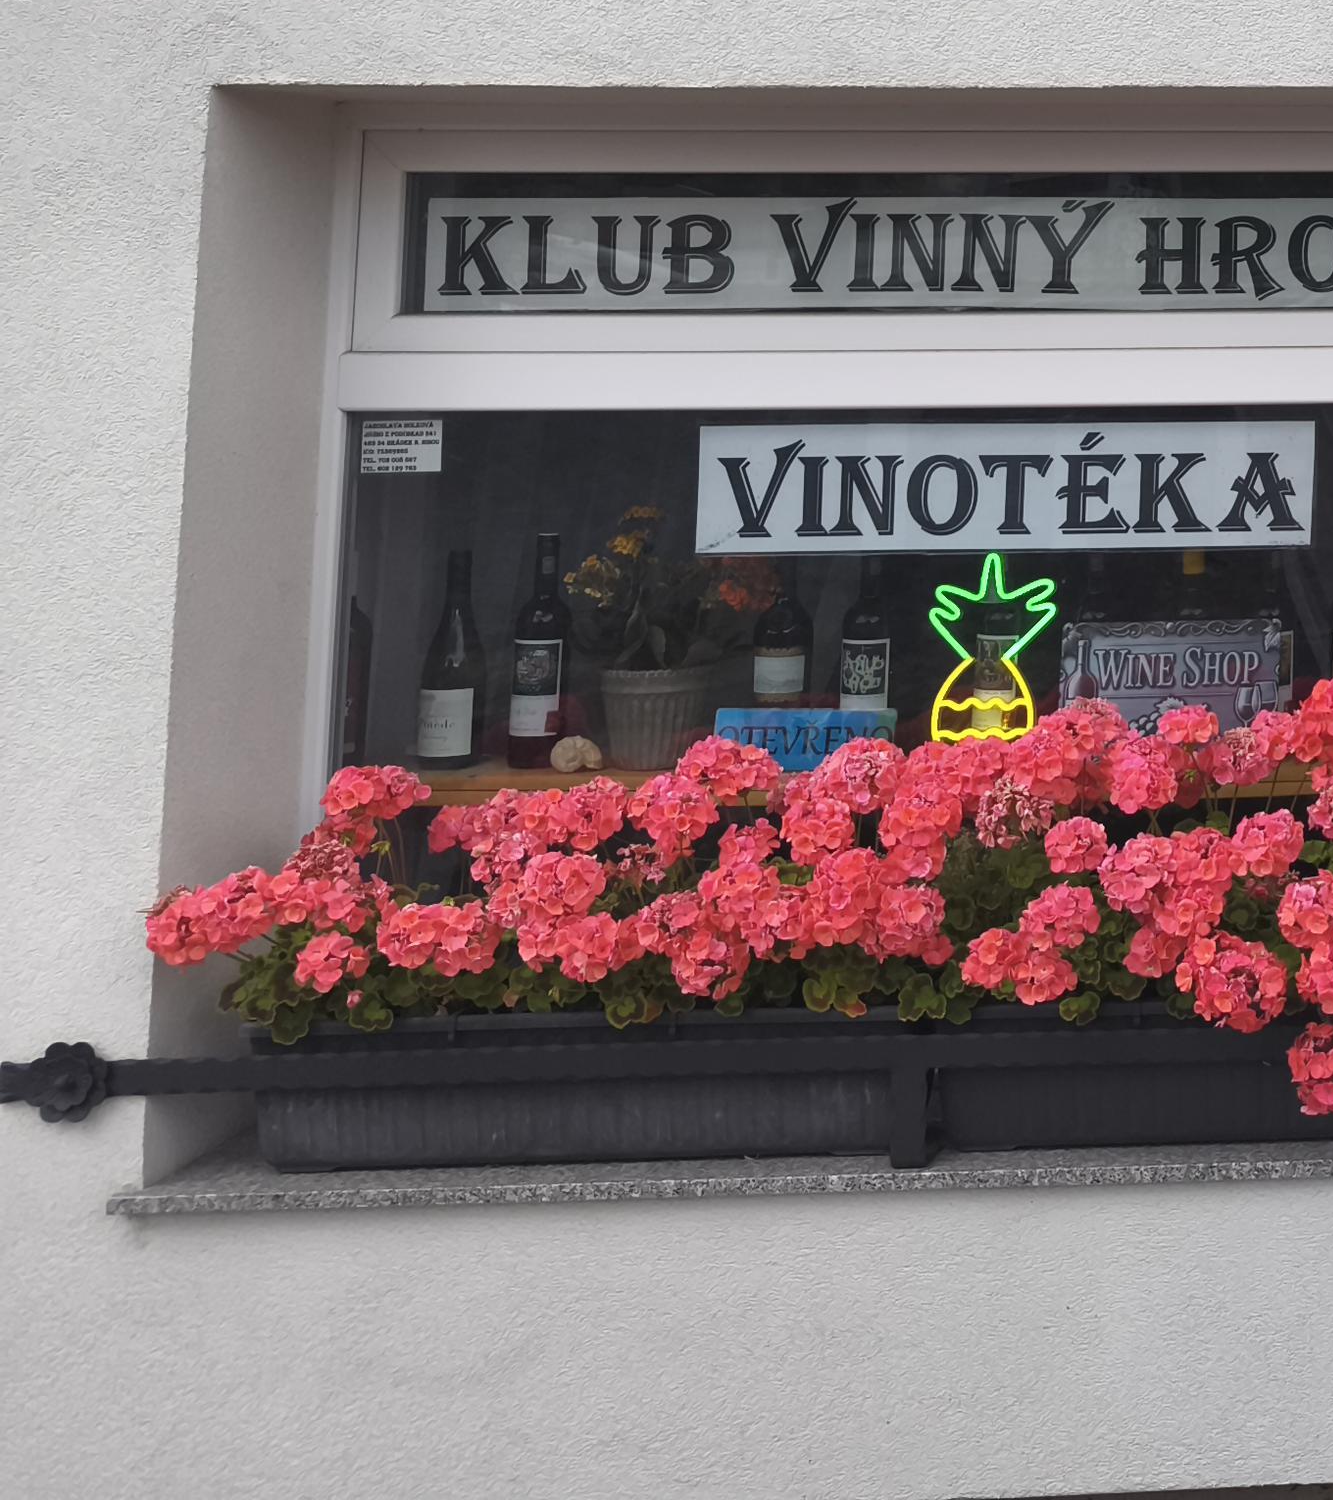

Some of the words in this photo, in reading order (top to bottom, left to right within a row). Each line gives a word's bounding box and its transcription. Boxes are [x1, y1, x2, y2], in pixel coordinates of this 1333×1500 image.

[438, 214, 735, 296] KLUB
[771, 197, 1115, 293] VINNÝ
[717, 431, 1305, 537] VINOTÉKA
[1095, 648, 1175, 689] WINE
[1182, 646, 1260, 688] SHOP
